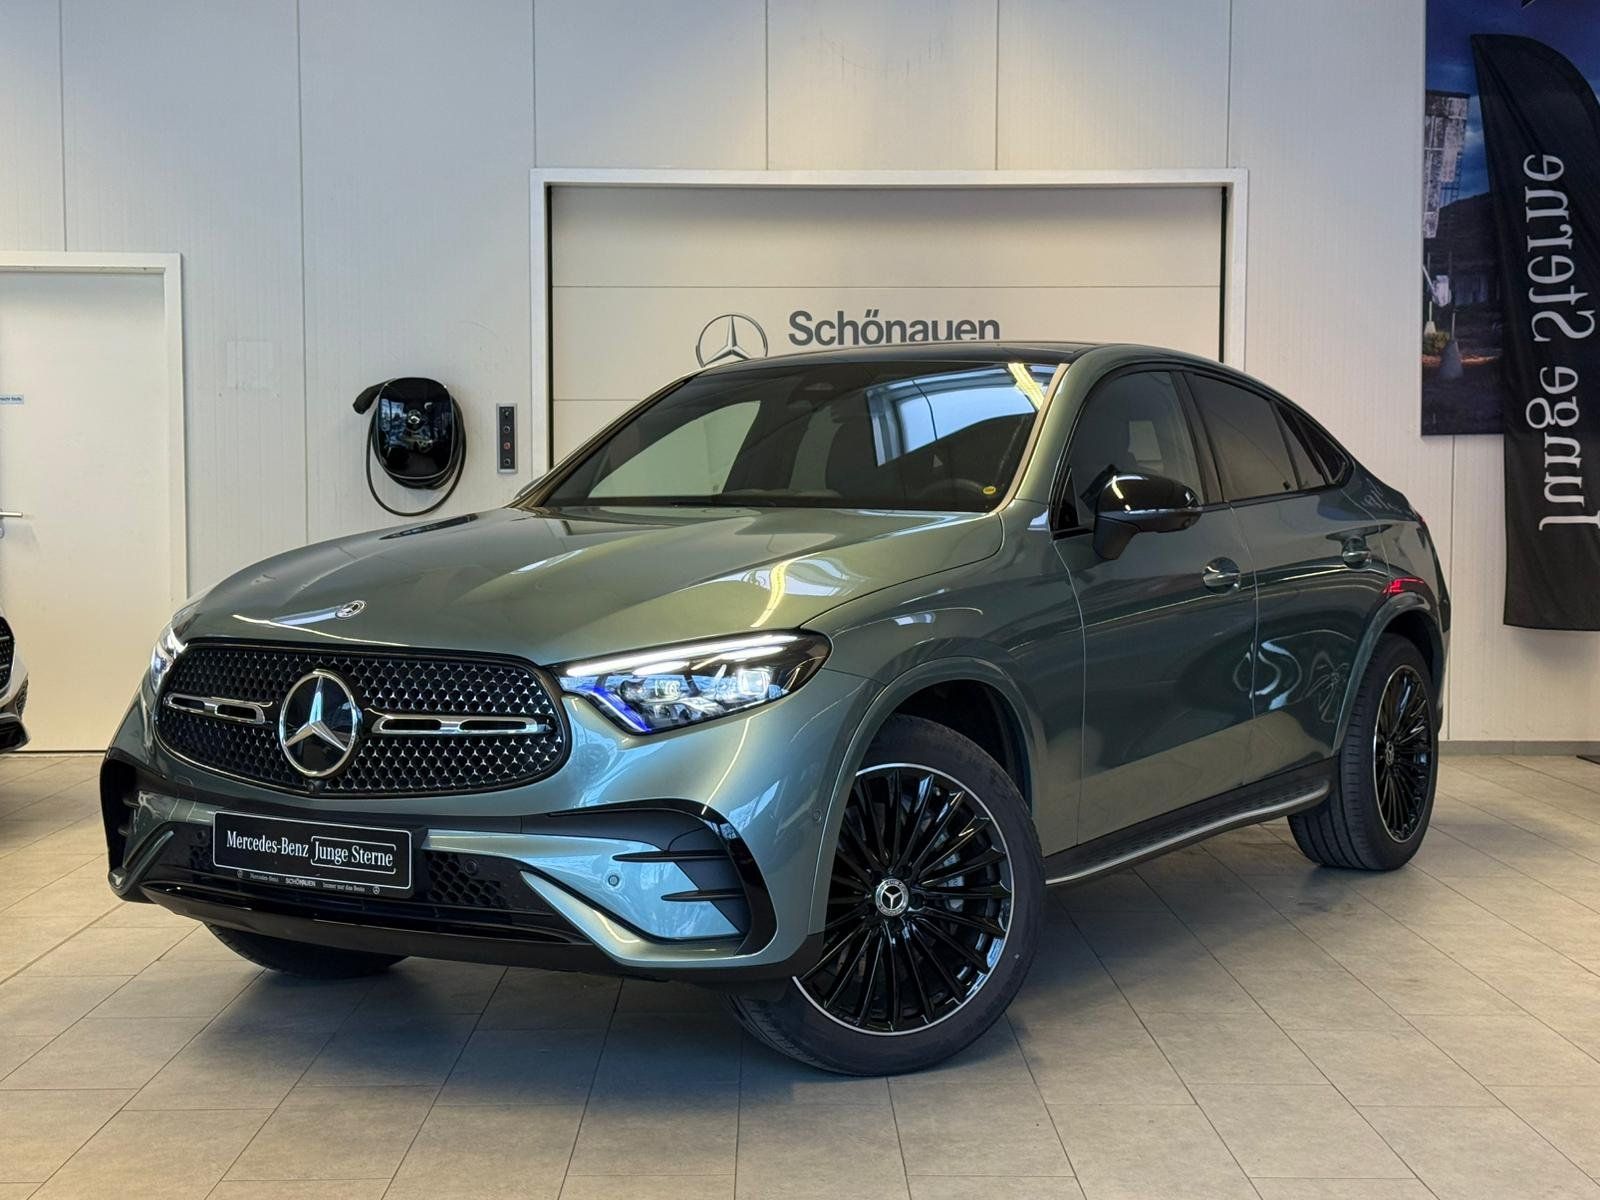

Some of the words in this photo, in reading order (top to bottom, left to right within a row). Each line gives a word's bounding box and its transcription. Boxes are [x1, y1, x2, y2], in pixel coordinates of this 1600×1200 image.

[788, 309, 1000, 346] Schönauen
[226, 830, 309, 858] Mercedes-Benz
[314, 841, 349, 865] Junge
[351, 845, 393, 867] Sterne
